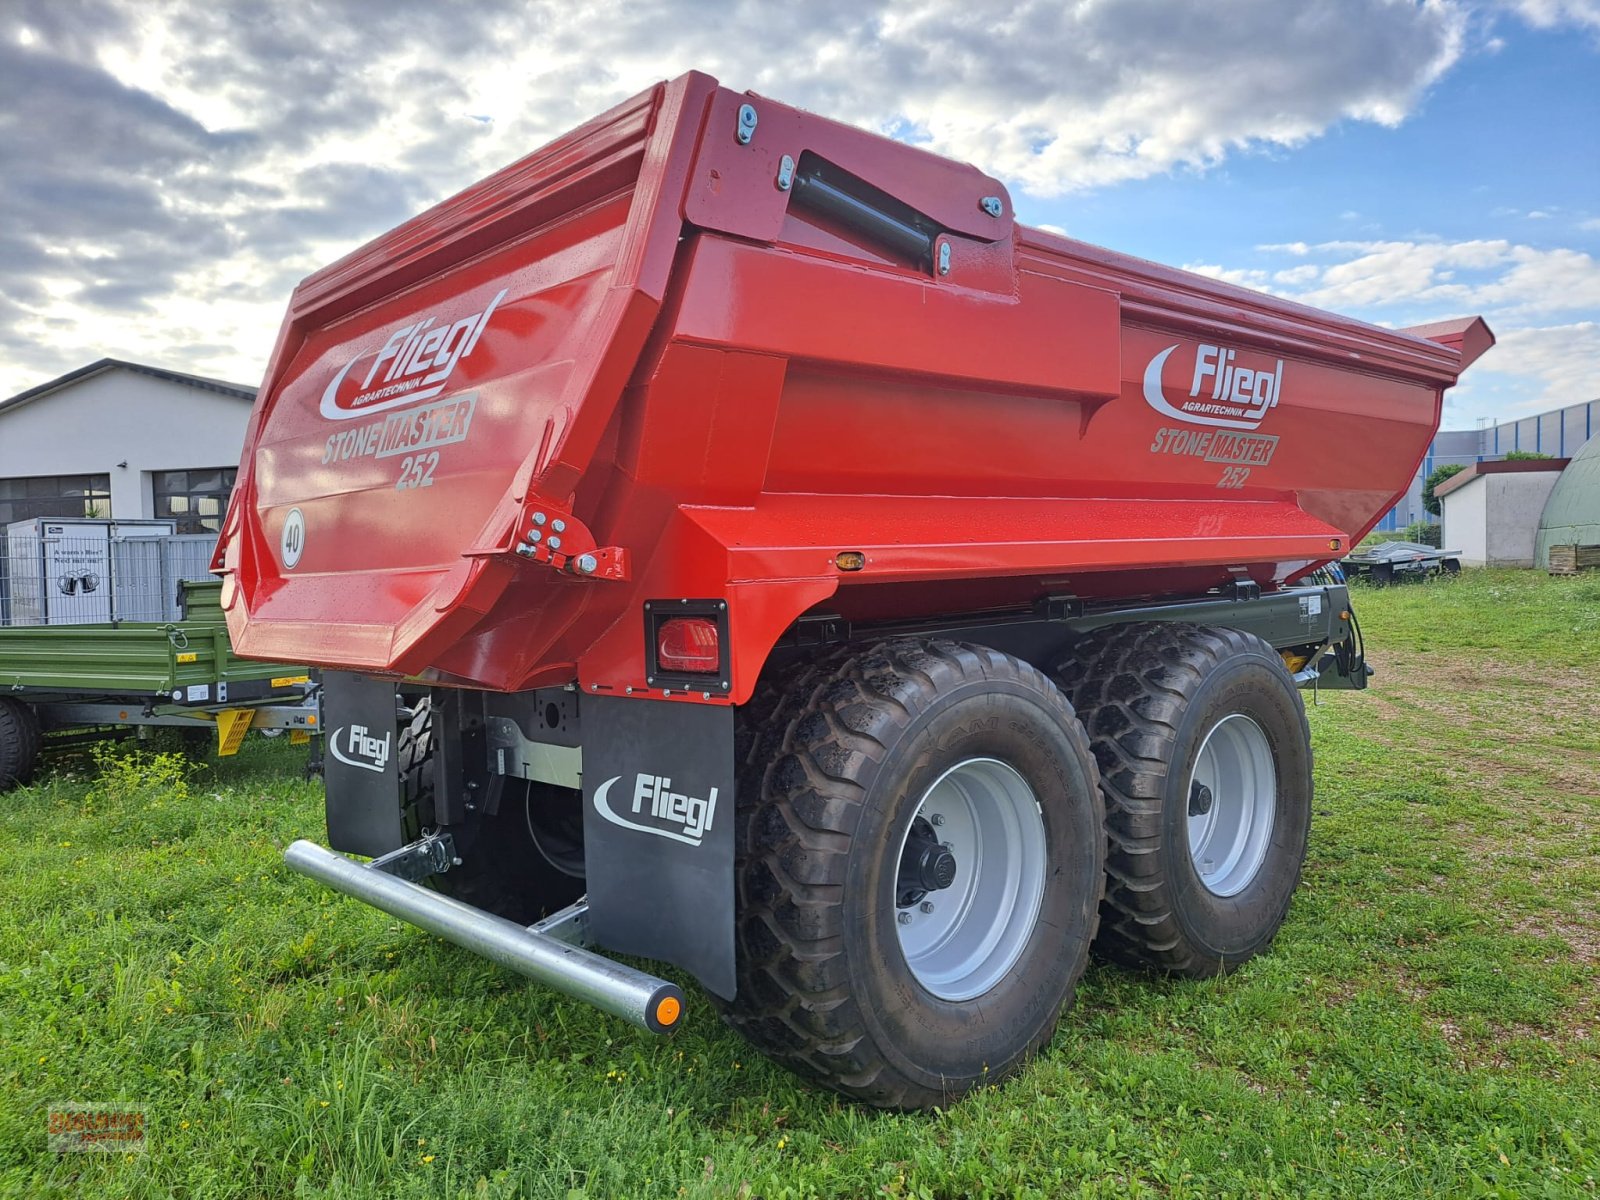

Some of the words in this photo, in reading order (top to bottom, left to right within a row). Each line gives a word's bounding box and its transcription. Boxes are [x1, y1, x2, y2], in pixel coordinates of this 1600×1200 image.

[360, 288, 509, 390] Fliegl
[351, 376, 424, 407] AGRARTECHNIK
[1189, 344, 1283, 419] Fliegl
[1181, 401, 1245, 417] AGRARTECHNIK
[395, 451, 440, 491] 252
[1216, 466, 1250, 489] 252
[286, 524, 300, 553] 40
[348, 724, 391, 766] Fliegl
[631, 773, 719, 836] Fliegl
